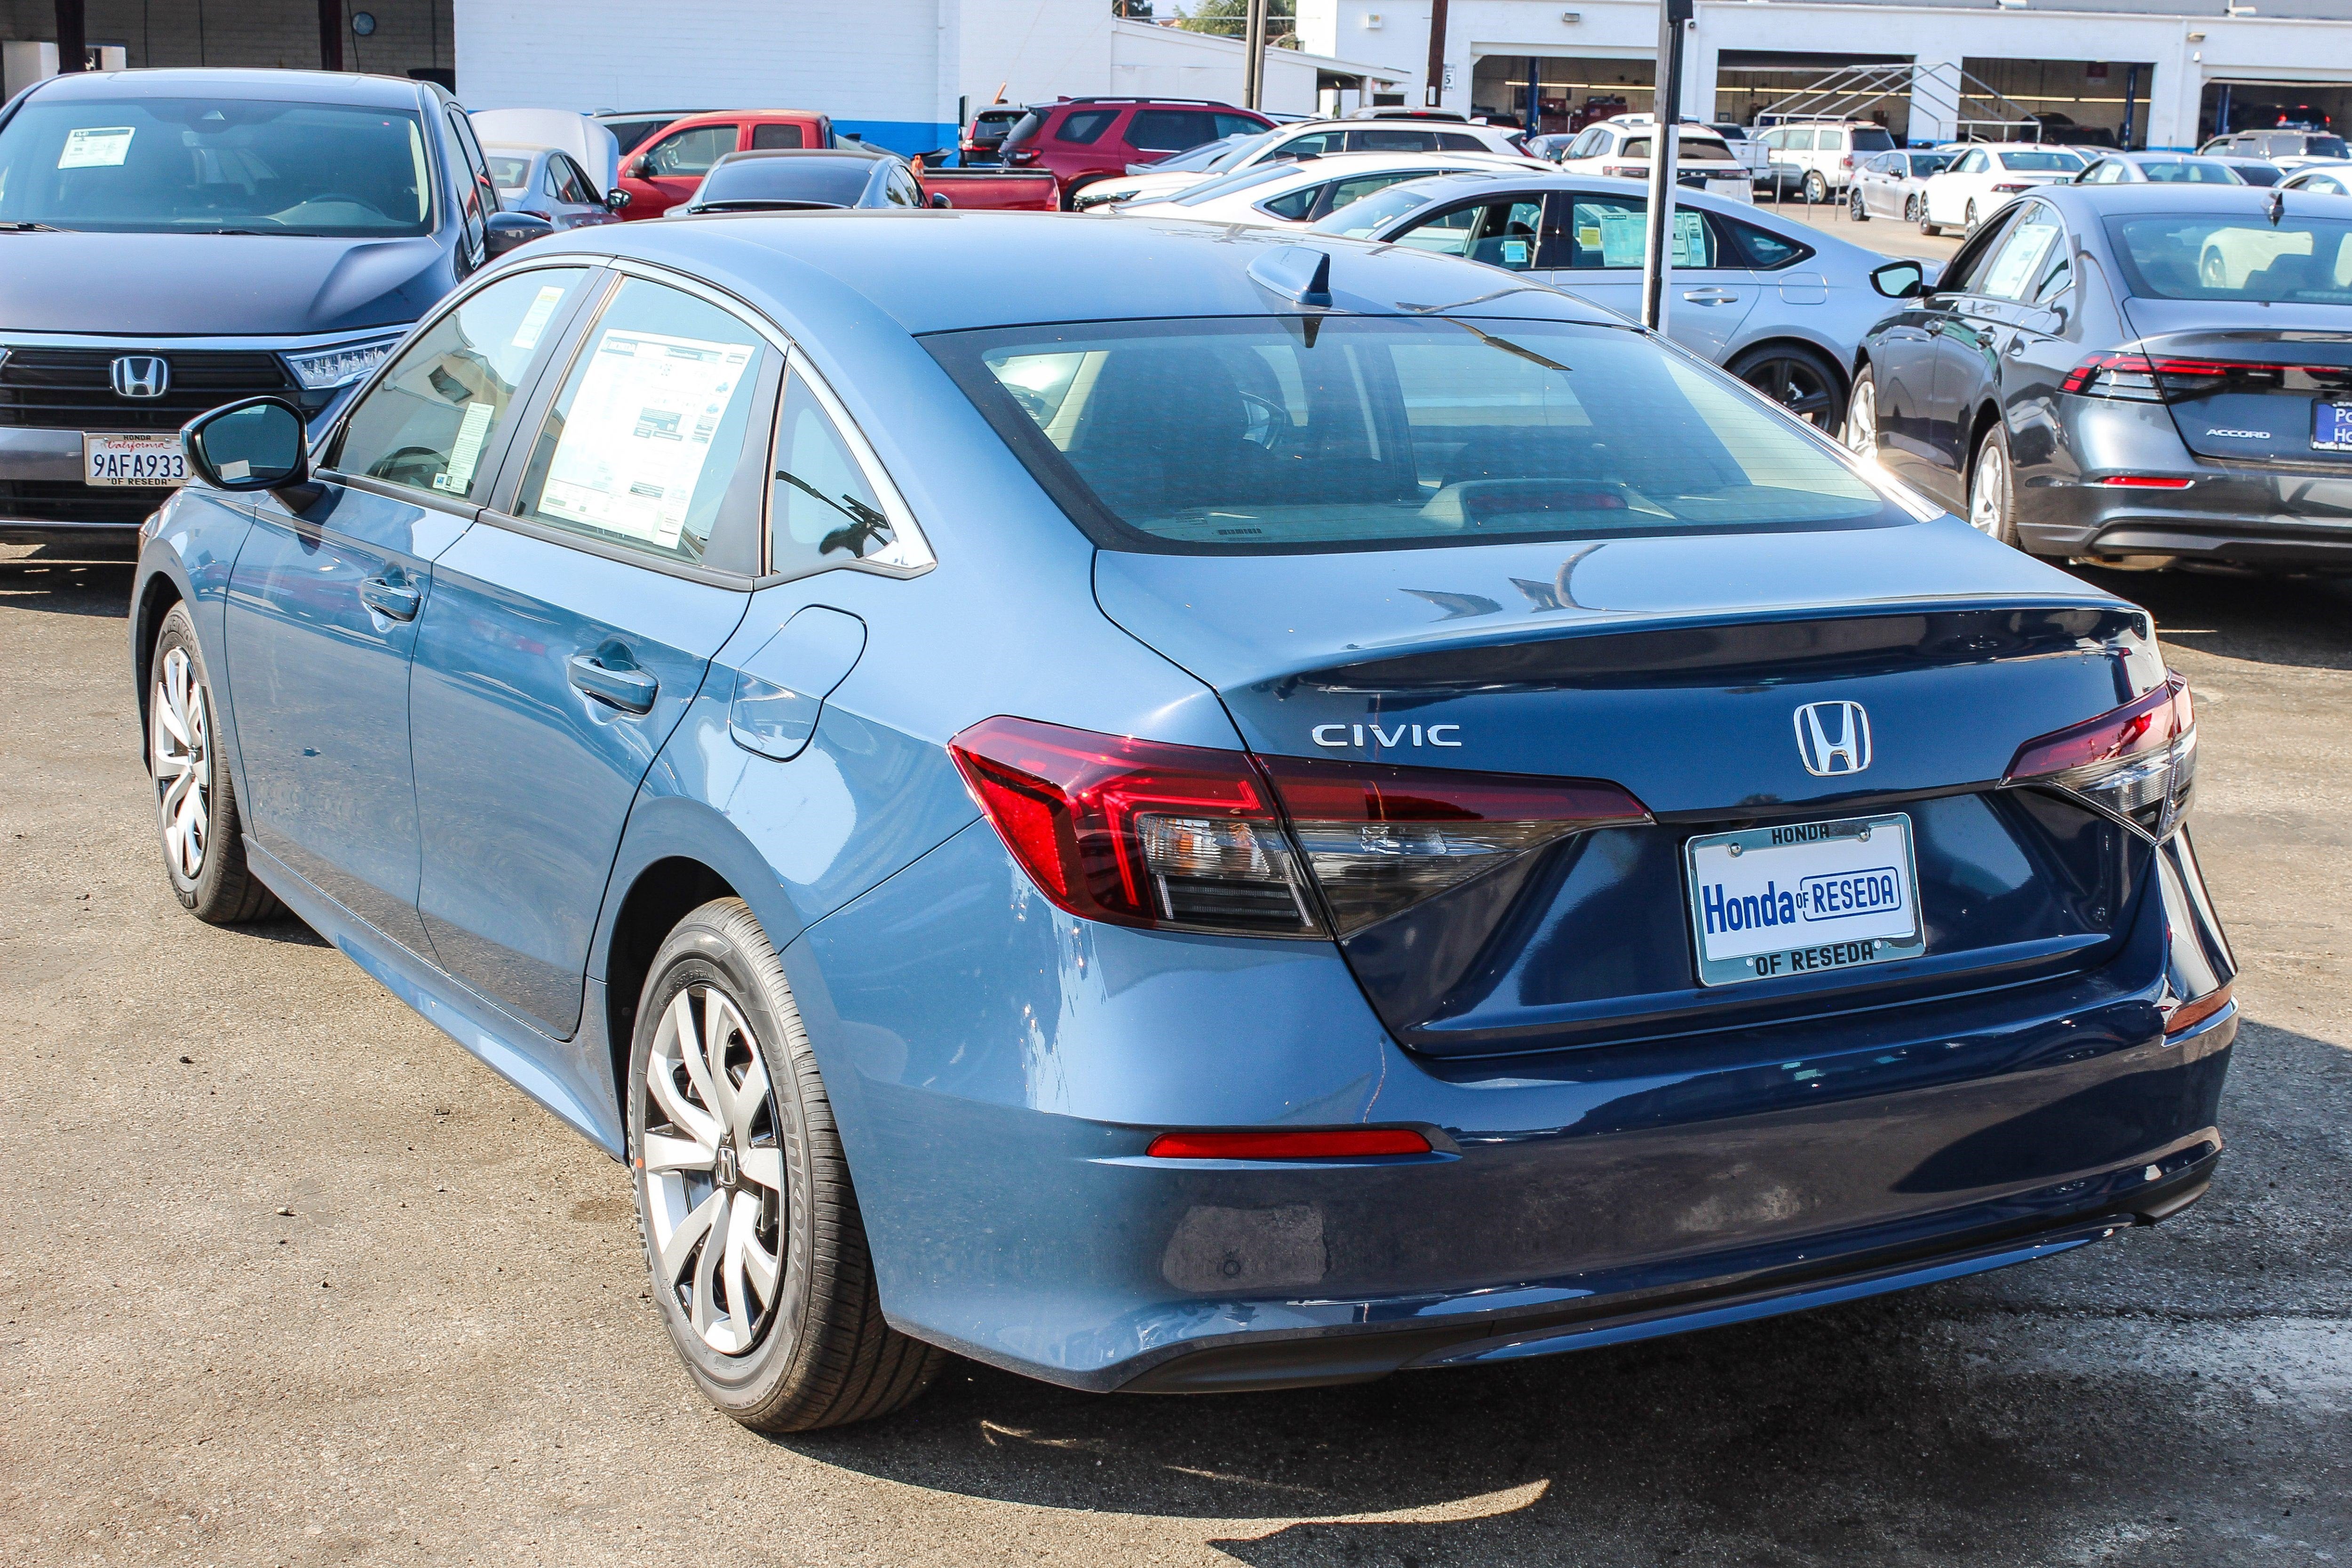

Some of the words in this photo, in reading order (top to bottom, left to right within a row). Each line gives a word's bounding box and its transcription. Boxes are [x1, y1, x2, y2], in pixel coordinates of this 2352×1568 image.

[1446, 75, 1451, 84] 5
[2206, 429, 2271, 439] ACCORD
[107, 441, 171, 452] California
[94, 454, 184, 477] 9AFA933
[1311, 724, 1462, 747] CIVIC
[1772, 823, 1830, 845] HONDA
[1702, 881, 1796, 934] Honda
[1796, 891, 1810, 909] OF
[1812, 875, 1894, 914] RESEDA
[1756, 953, 1782, 977] OF
[1792, 941, 1875, 972] RESEDA
